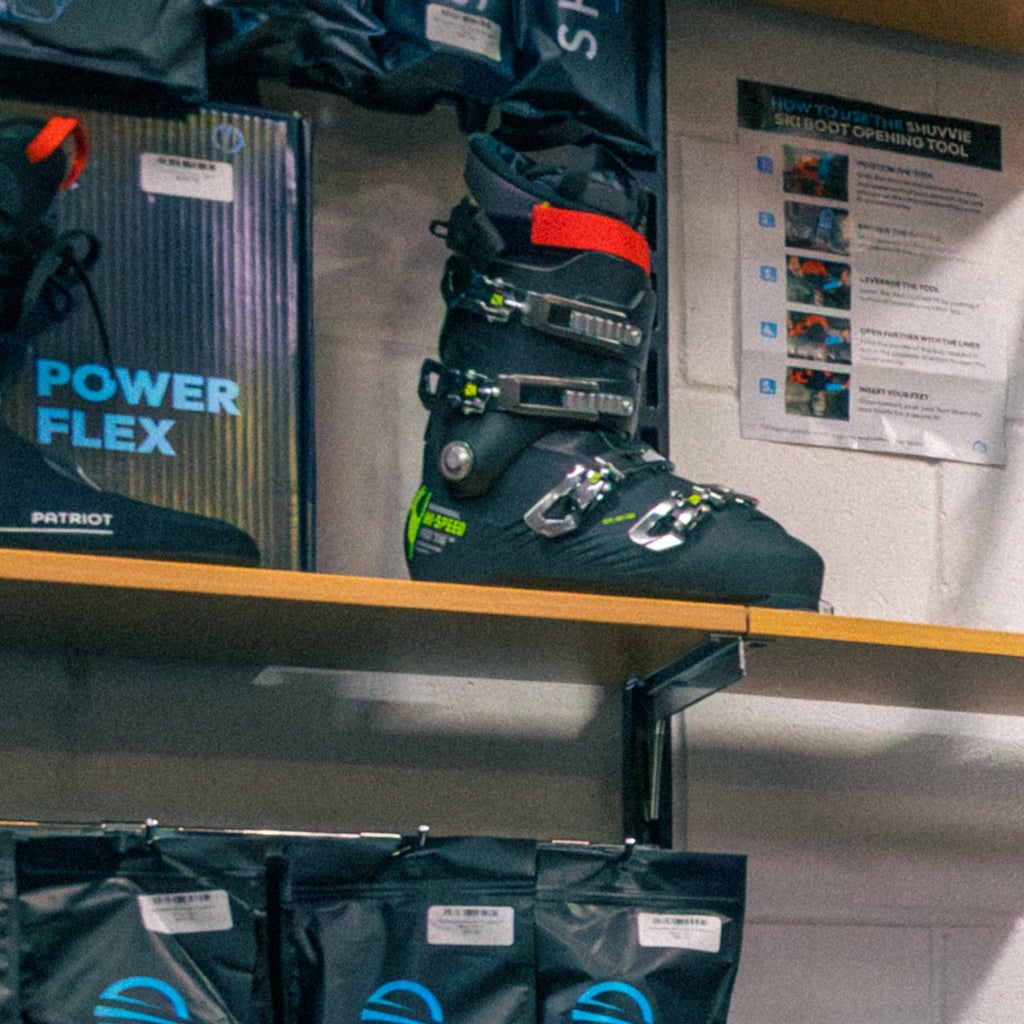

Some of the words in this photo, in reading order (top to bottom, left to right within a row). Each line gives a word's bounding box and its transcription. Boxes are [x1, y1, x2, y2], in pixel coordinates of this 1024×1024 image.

[771, 96, 811, 113] HOW
[816, 102, 838, 118] TO
[841, 107, 868, 124] USE
[873, 113, 902, 129] THE
[906, 121, 972, 143] SHUVVIE
[775, 113, 800, 128] SKI
[804, 116, 849, 135] BOOT
[852, 125, 923, 148] OPENING
[928, 137, 969, 158] TOOL
[36, 358, 241, 416] POWER
[36, 406, 176, 457] FLEX
[31, 511, 113, 526] PATRIOT
